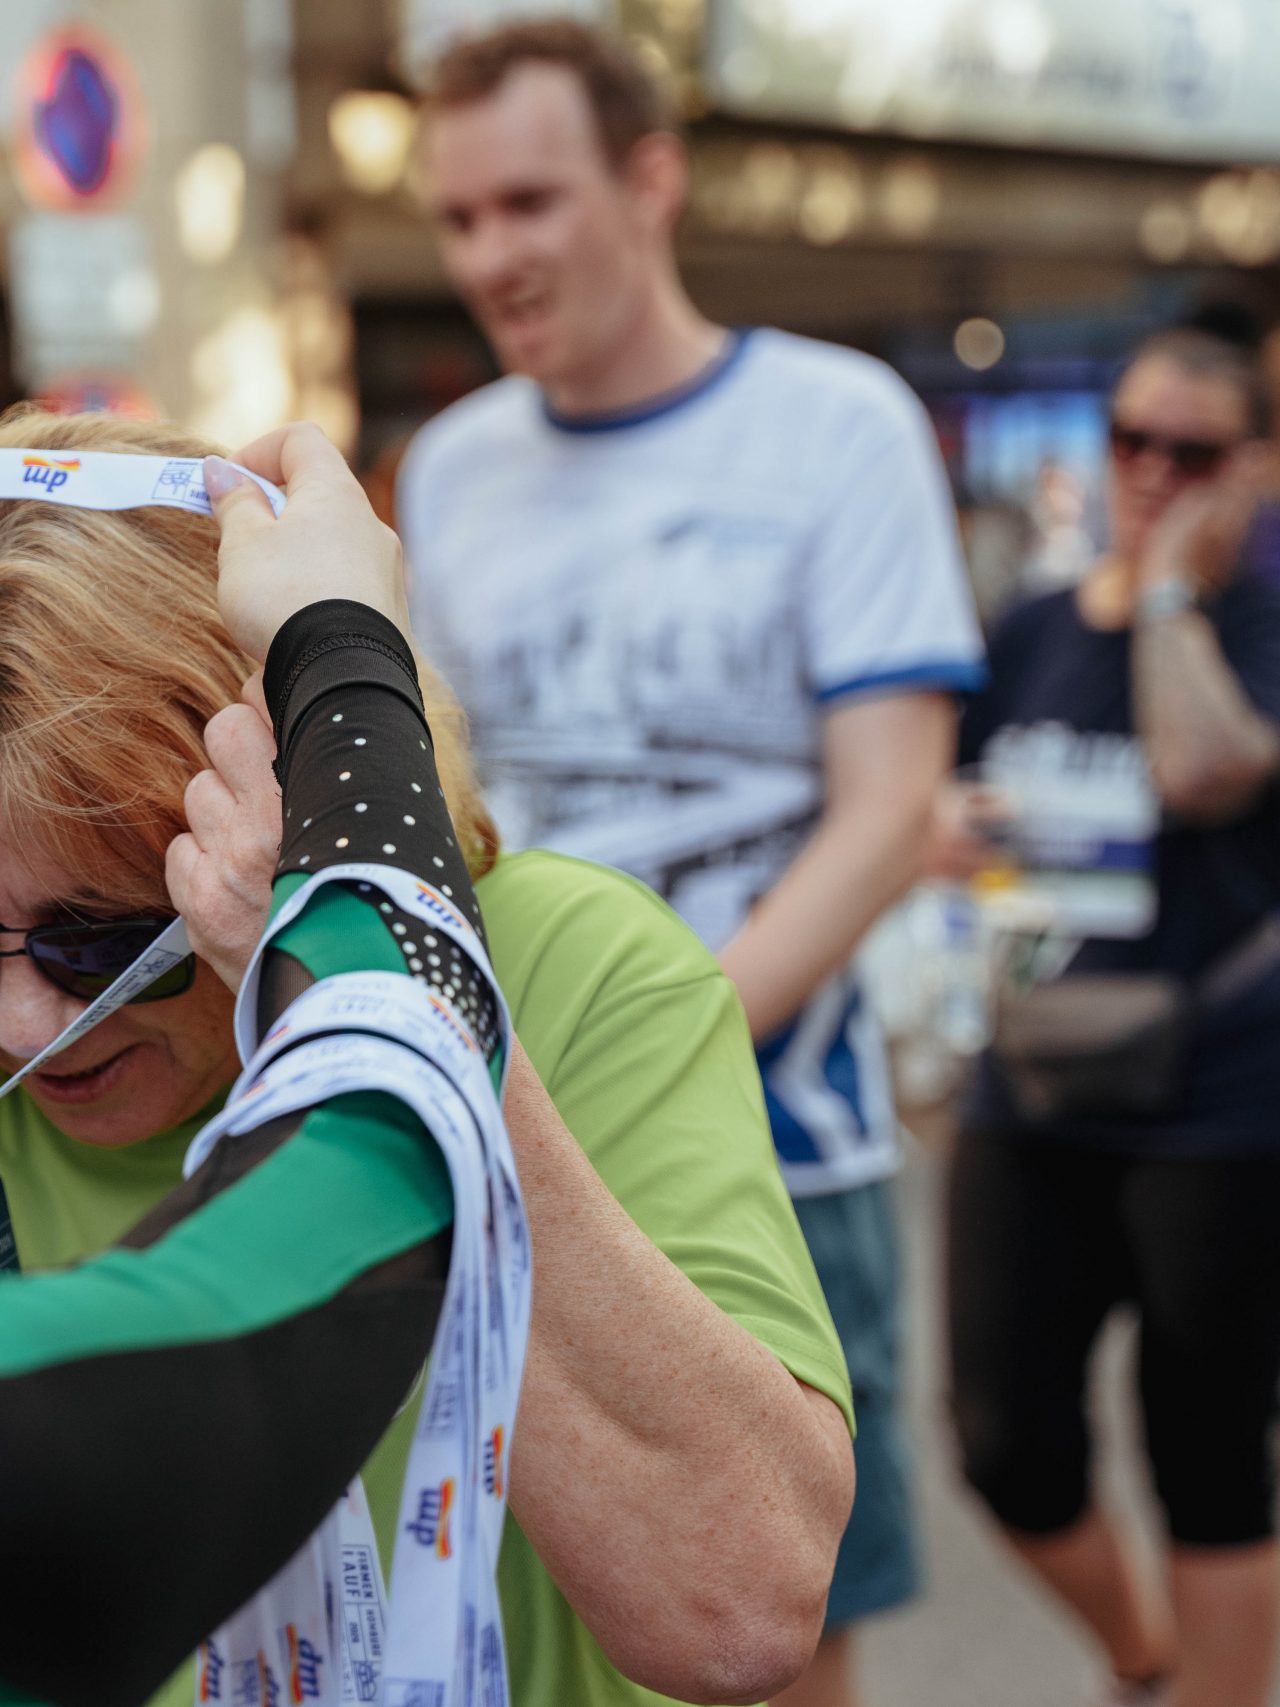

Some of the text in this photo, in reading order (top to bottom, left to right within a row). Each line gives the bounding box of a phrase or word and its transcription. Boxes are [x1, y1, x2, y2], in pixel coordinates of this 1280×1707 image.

[22, 465, 68, 493] dm
[404, 1488, 442, 1547] dm
[357, 1551, 374, 1599] FIRMEN
[299, 1637, 323, 1697] dm
